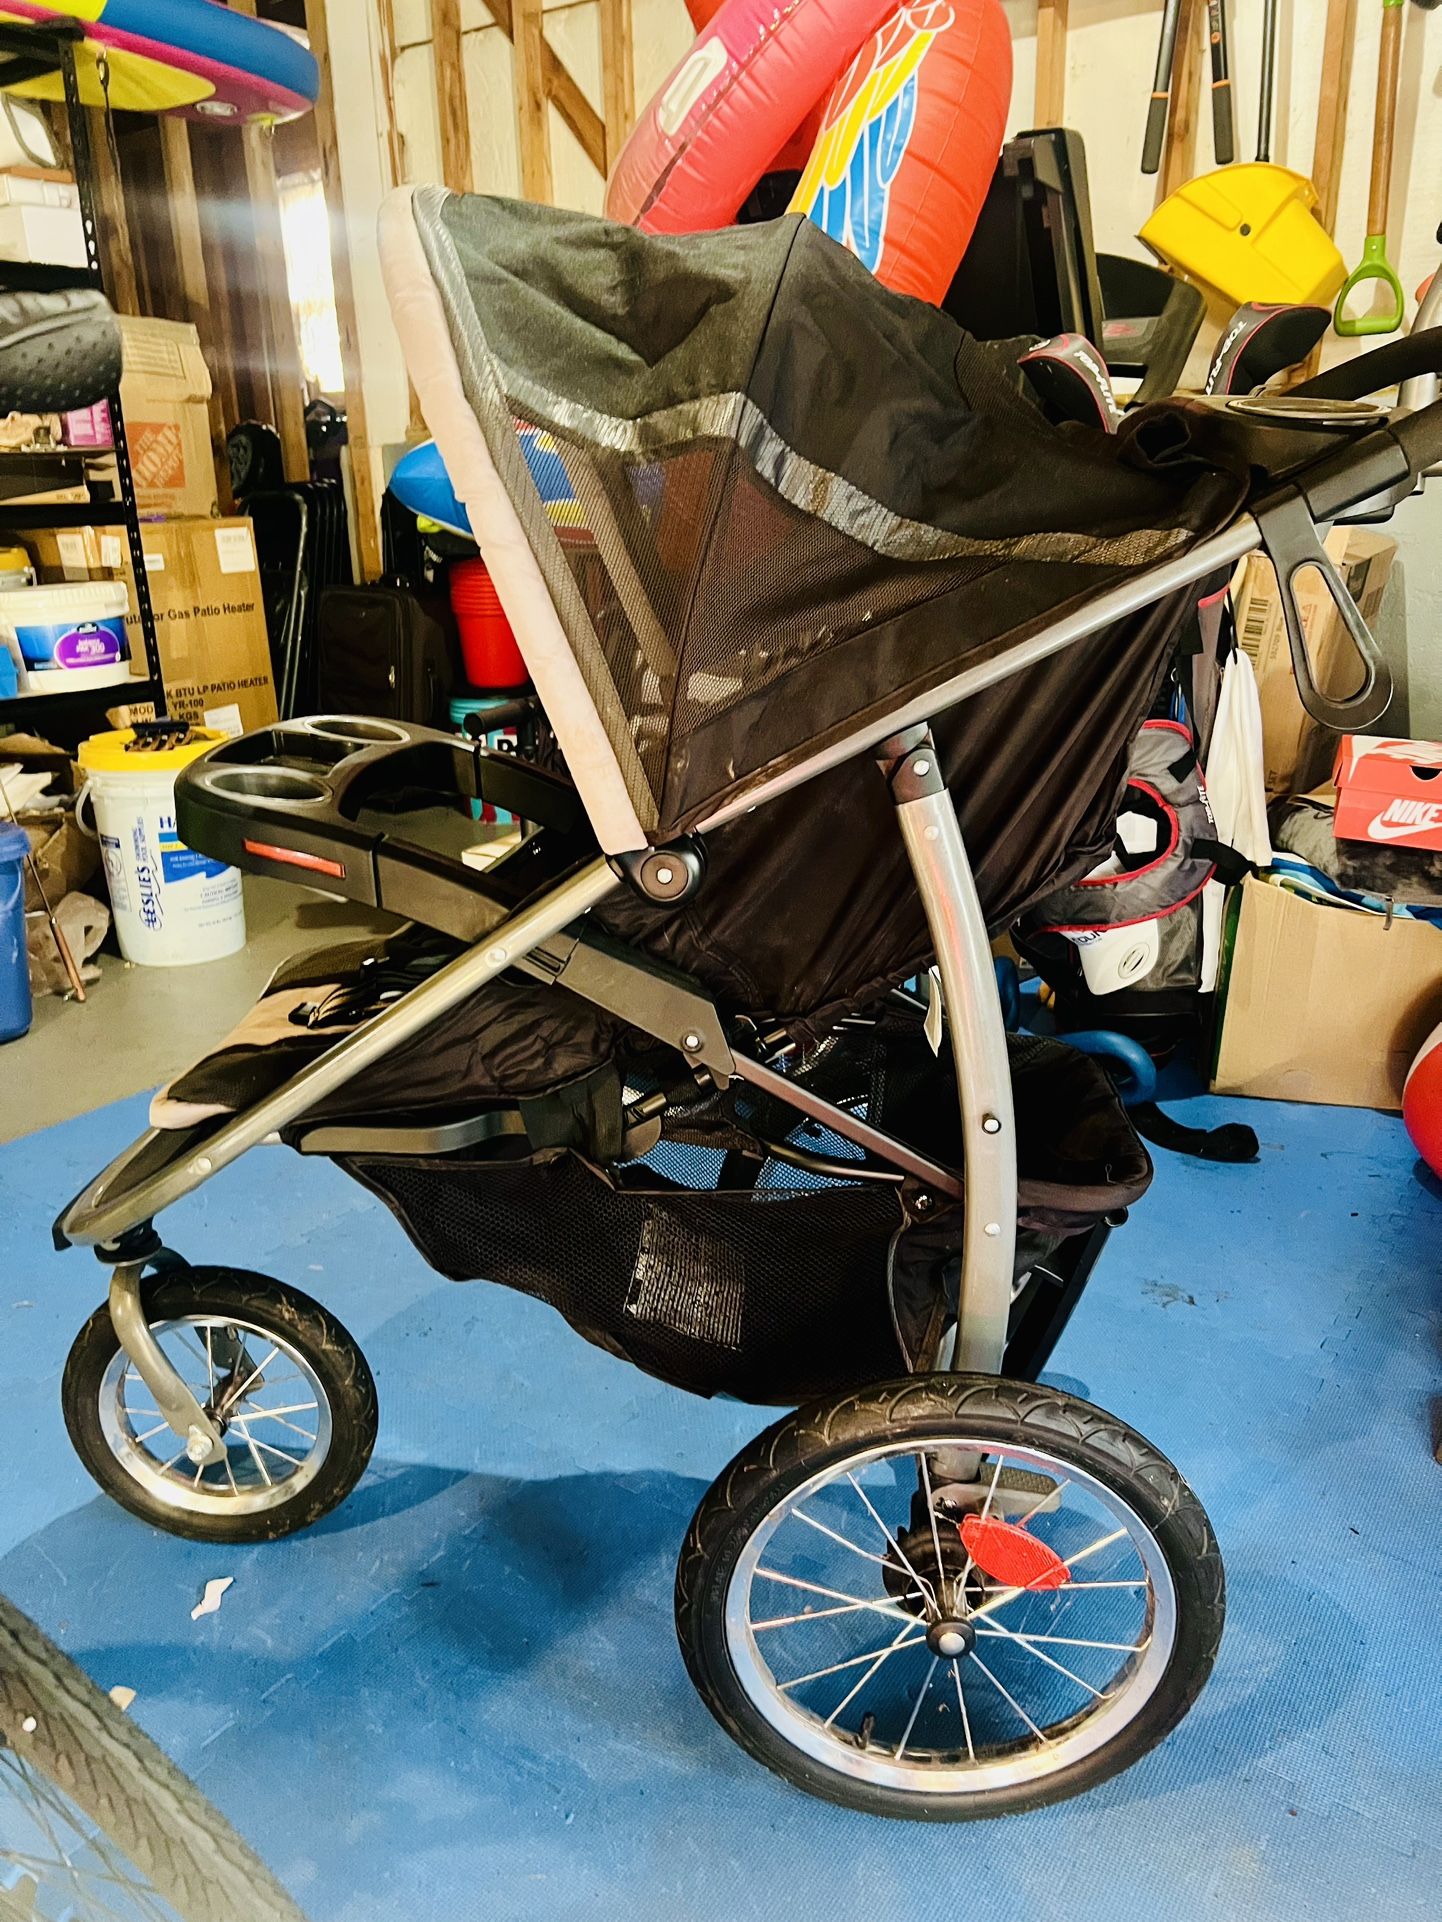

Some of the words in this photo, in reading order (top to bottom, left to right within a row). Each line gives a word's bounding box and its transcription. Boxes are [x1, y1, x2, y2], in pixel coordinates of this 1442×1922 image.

[133, 431, 155, 454] THE
[132, 424, 178, 487] HOME
[167, 608, 191, 621] Gas
[193, 604, 221, 618] Patio
[222, 602, 255, 615] Heater
[175, 686, 195, 698] BTU
[197, 684, 209, 695] LP
[211, 680, 236, 693] PATIO
[237, 676, 269, 690] HEATER
[172, 697, 204, 711] YR-100
[1382, 798, 1442, 826] NIKE
